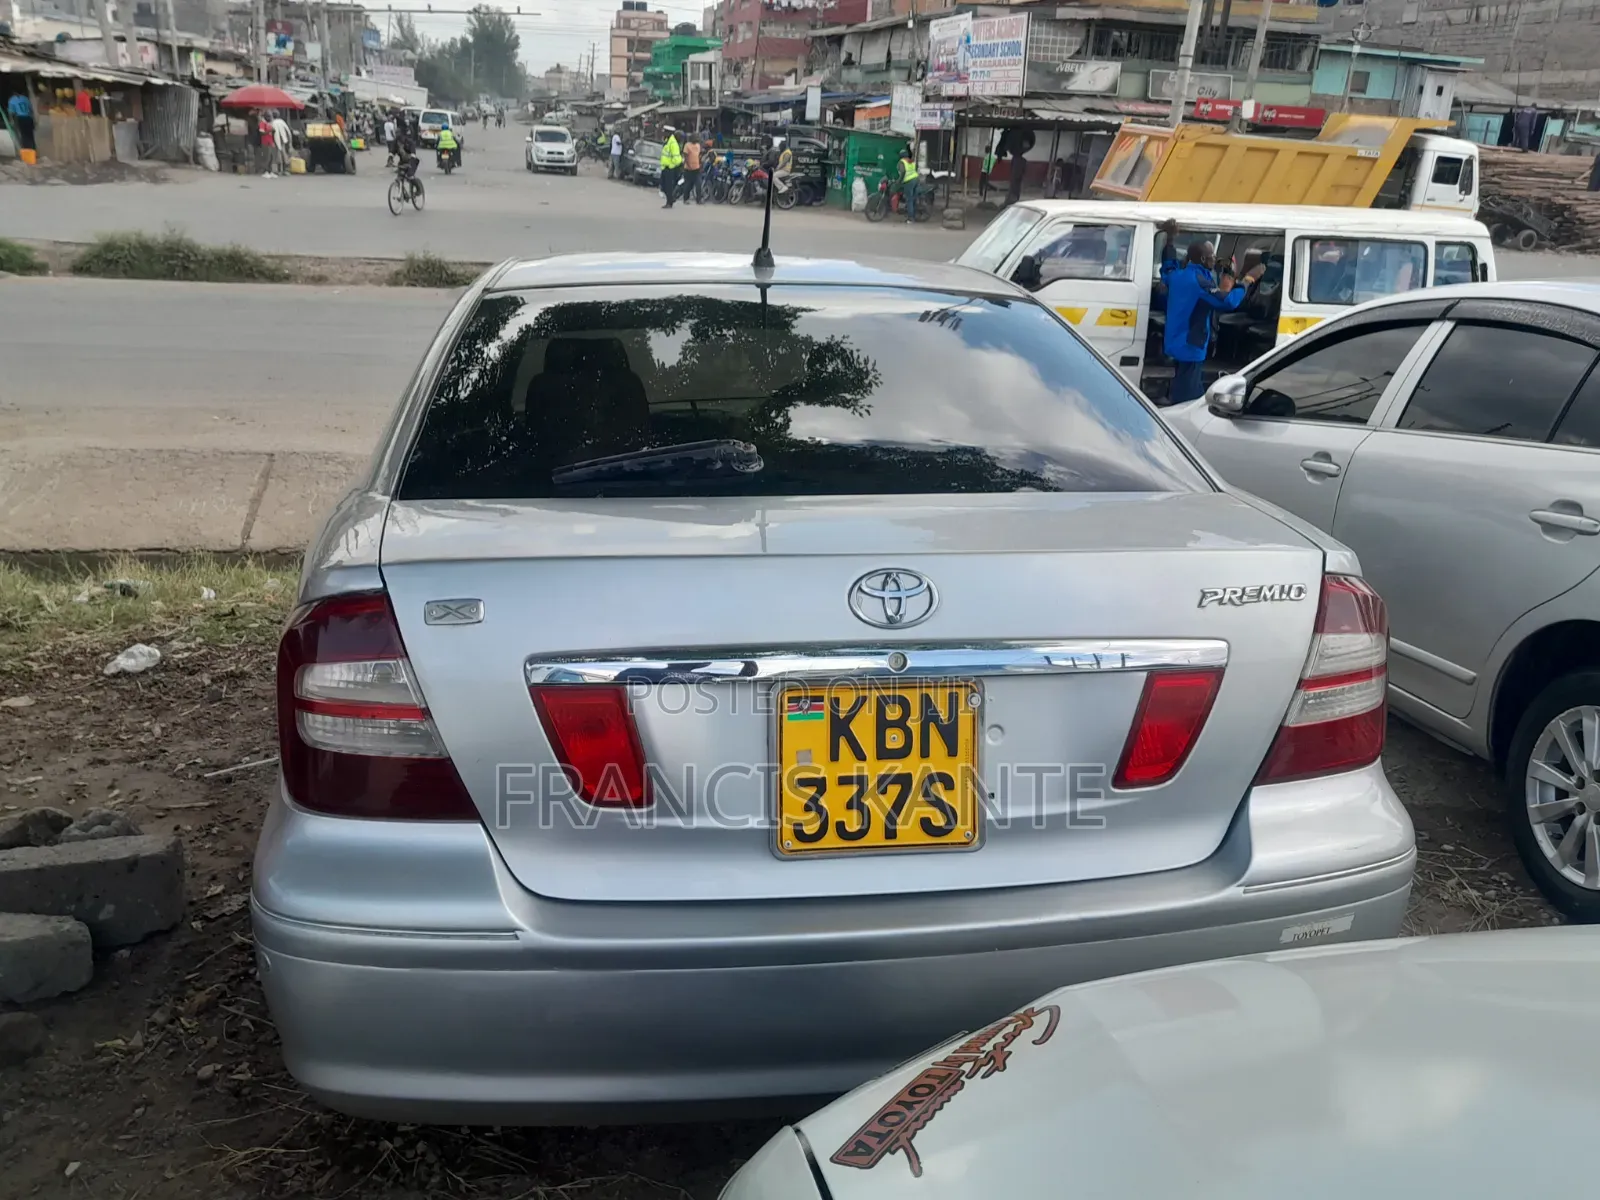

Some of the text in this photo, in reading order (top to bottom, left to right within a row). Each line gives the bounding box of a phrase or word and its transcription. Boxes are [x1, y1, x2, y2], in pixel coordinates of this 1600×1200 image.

[1000, 40, 1021, 57] SCHOOL
[1197, 87, 1218, 98] City
[1198, 583, 1307, 609] PREMIO
[829, 691, 959, 762] KBN
[794, 772, 959, 845] 337S
[1293, 926, 1331, 942] TOYOPET
[843, 1072, 953, 1158] TOYOTA
